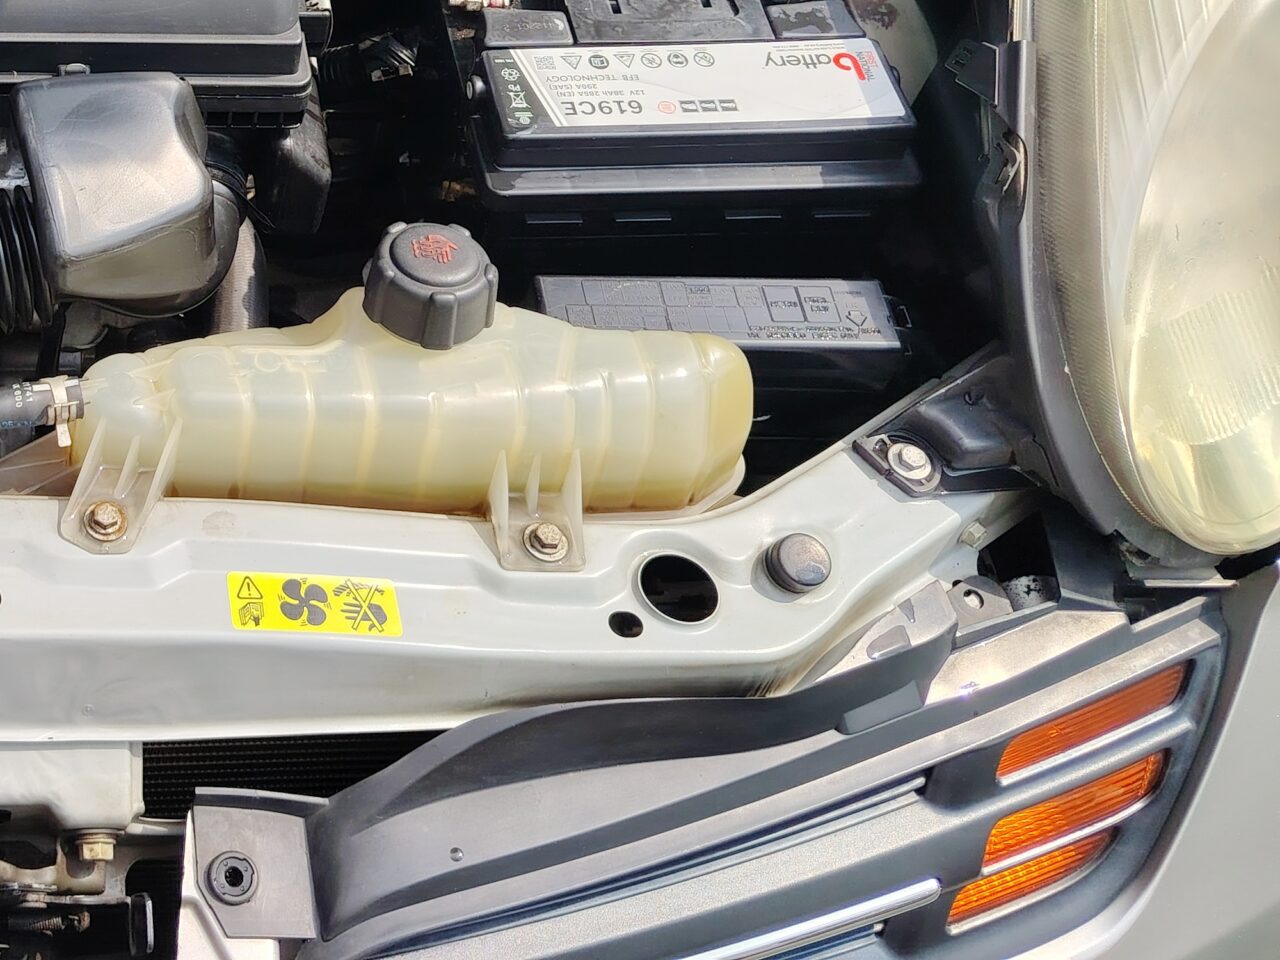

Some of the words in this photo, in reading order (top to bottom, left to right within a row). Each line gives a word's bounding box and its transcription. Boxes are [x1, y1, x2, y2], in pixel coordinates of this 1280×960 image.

[545, 74, 617, 83] TECHNOLOGY
[621, 73, 640, 82] EFB
[548, 83, 573, 91] (SAE)
[560, 99, 643, 116] 619CE
